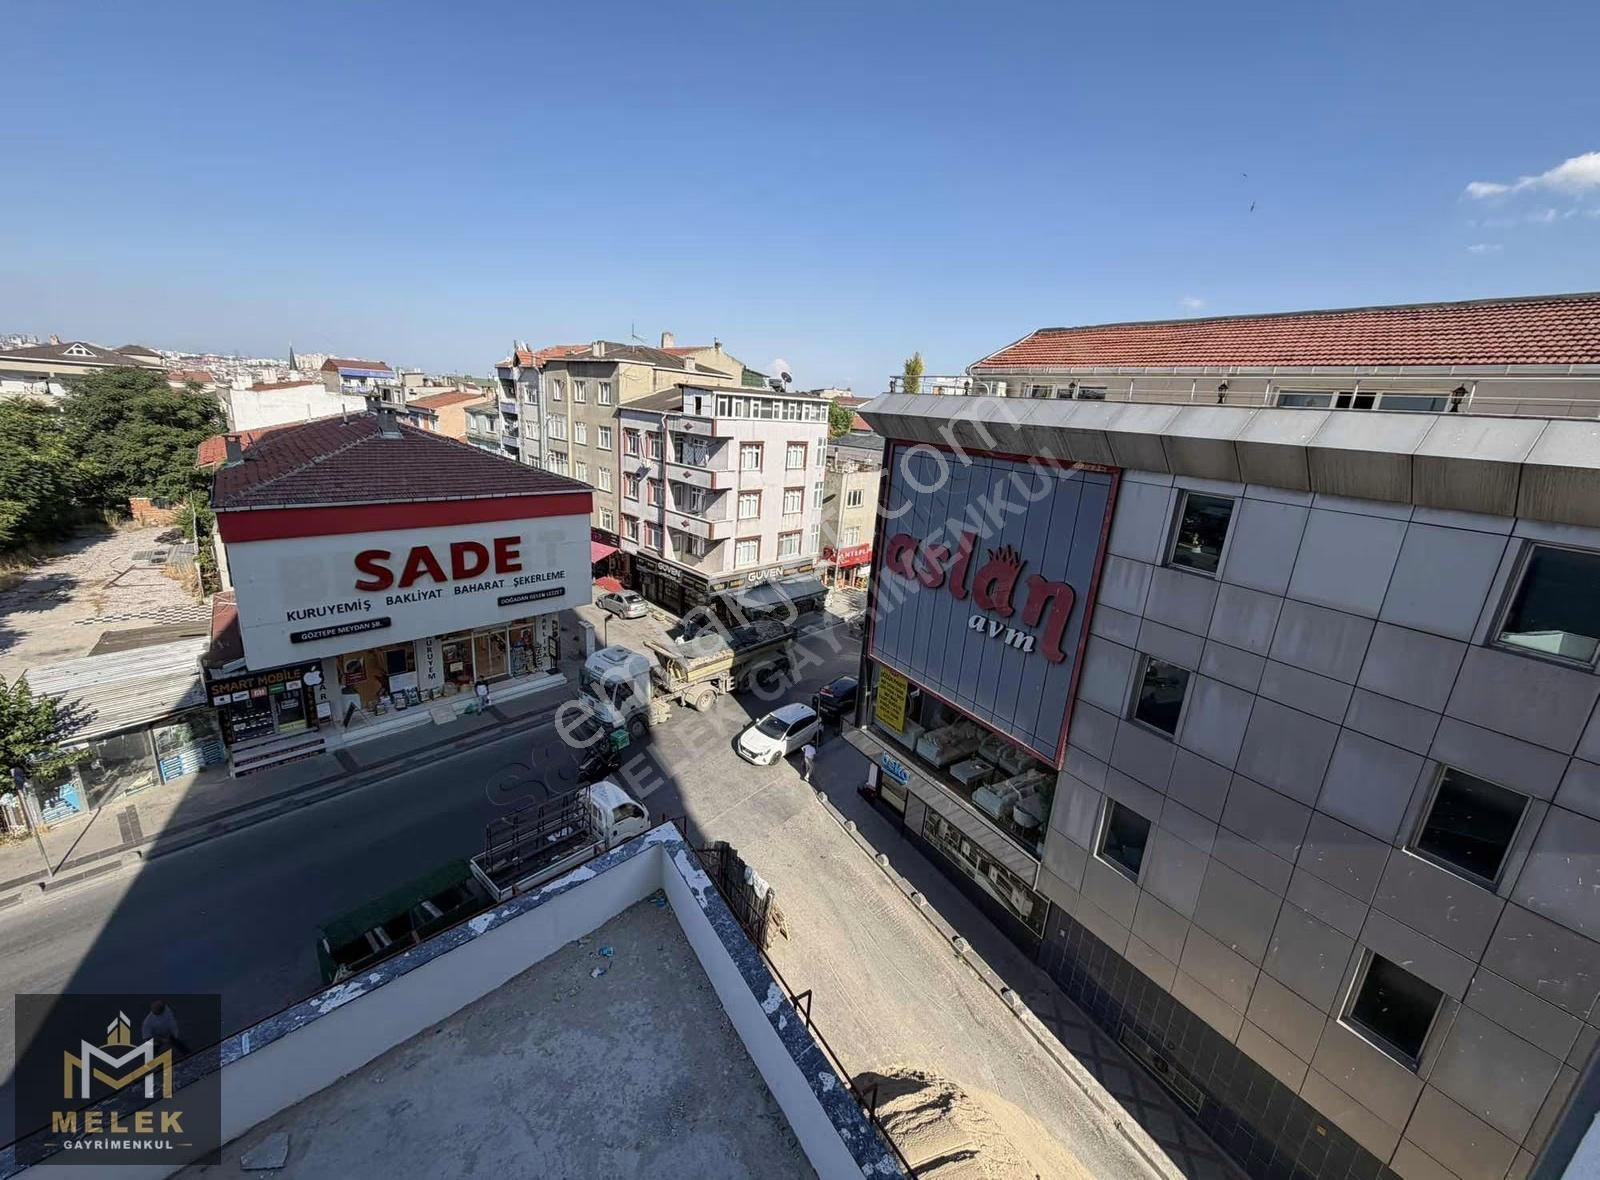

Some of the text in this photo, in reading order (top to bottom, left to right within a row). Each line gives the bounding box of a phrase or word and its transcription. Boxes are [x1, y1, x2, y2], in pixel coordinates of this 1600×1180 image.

[354, 536, 523, 592] SADE
[286, 570, 566, 622] KURUYEMİŞ BAKLİYAT BAHARAT ŞEKERLEME
[885, 531, 1076, 665] aslan
[301, 627, 337, 641] GÖZTEPE
[338, 621, 371, 634] MEYDAN
[968, 613, 1036, 653] avm
[211, 678, 254, 696] SMART
